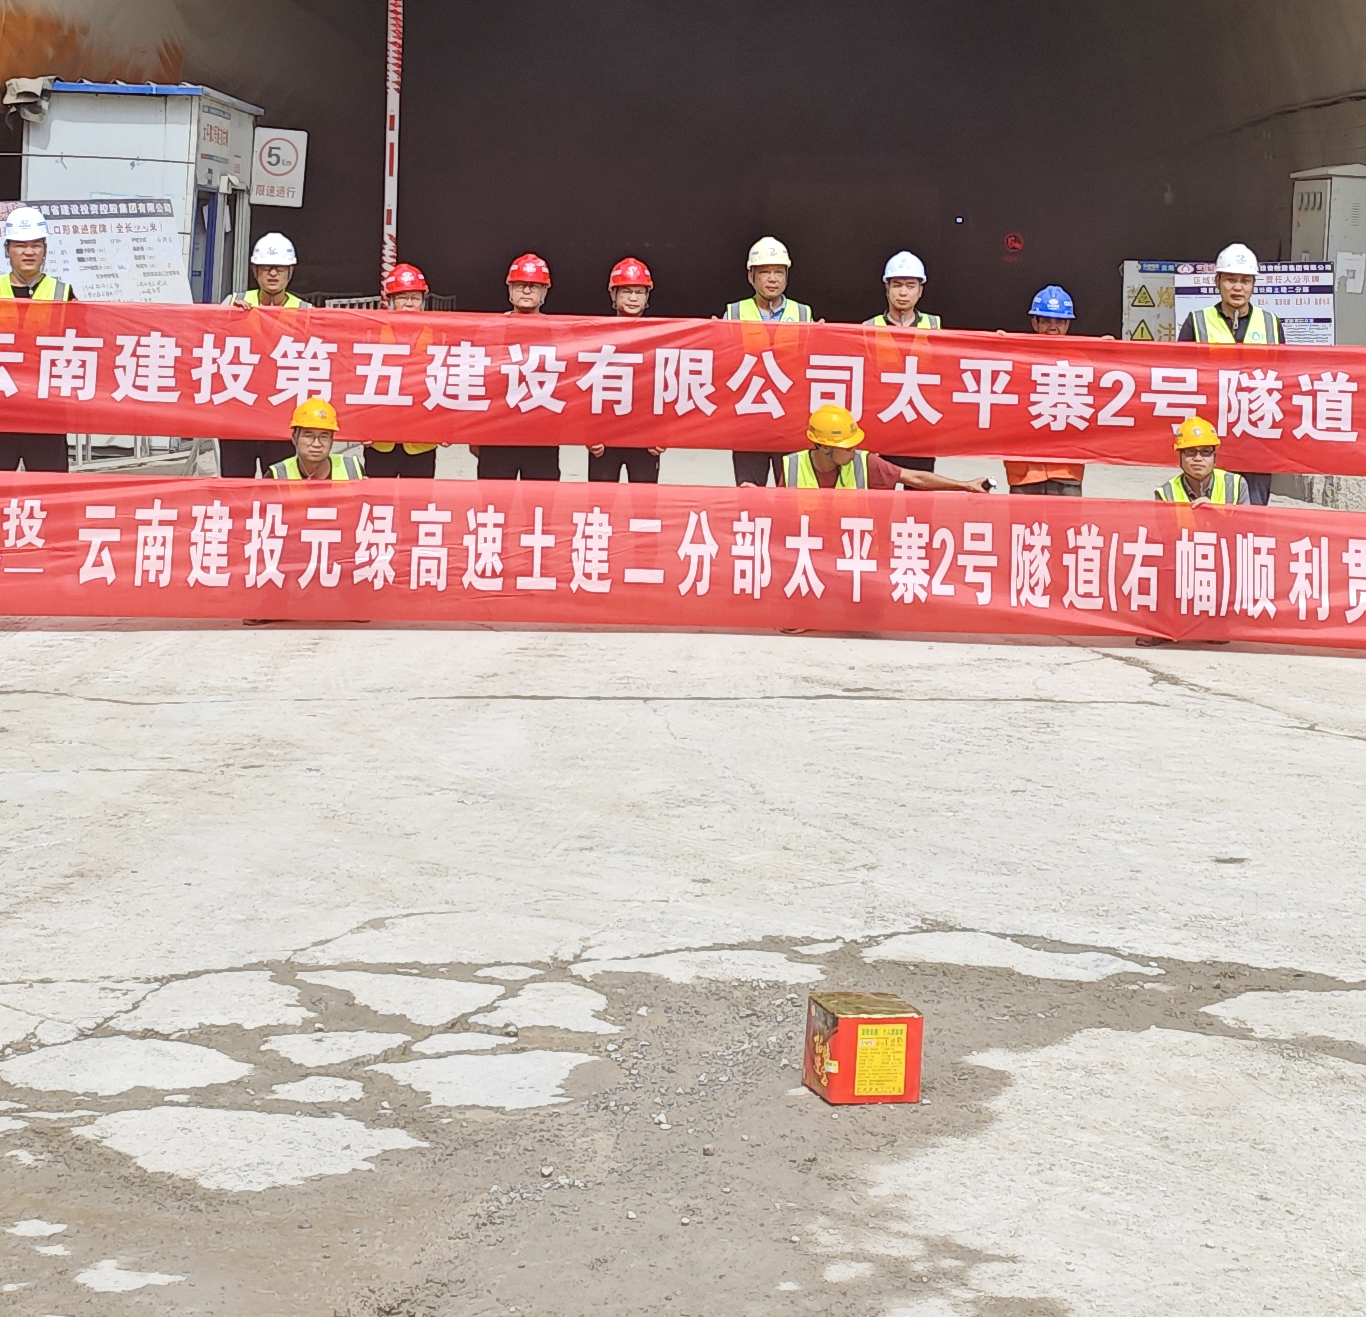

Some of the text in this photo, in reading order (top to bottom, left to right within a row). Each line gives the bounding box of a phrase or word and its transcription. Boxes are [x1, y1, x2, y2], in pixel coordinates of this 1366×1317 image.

[267, 146, 281, 167] 5
[255, 184, 296, 199] 限速通行
